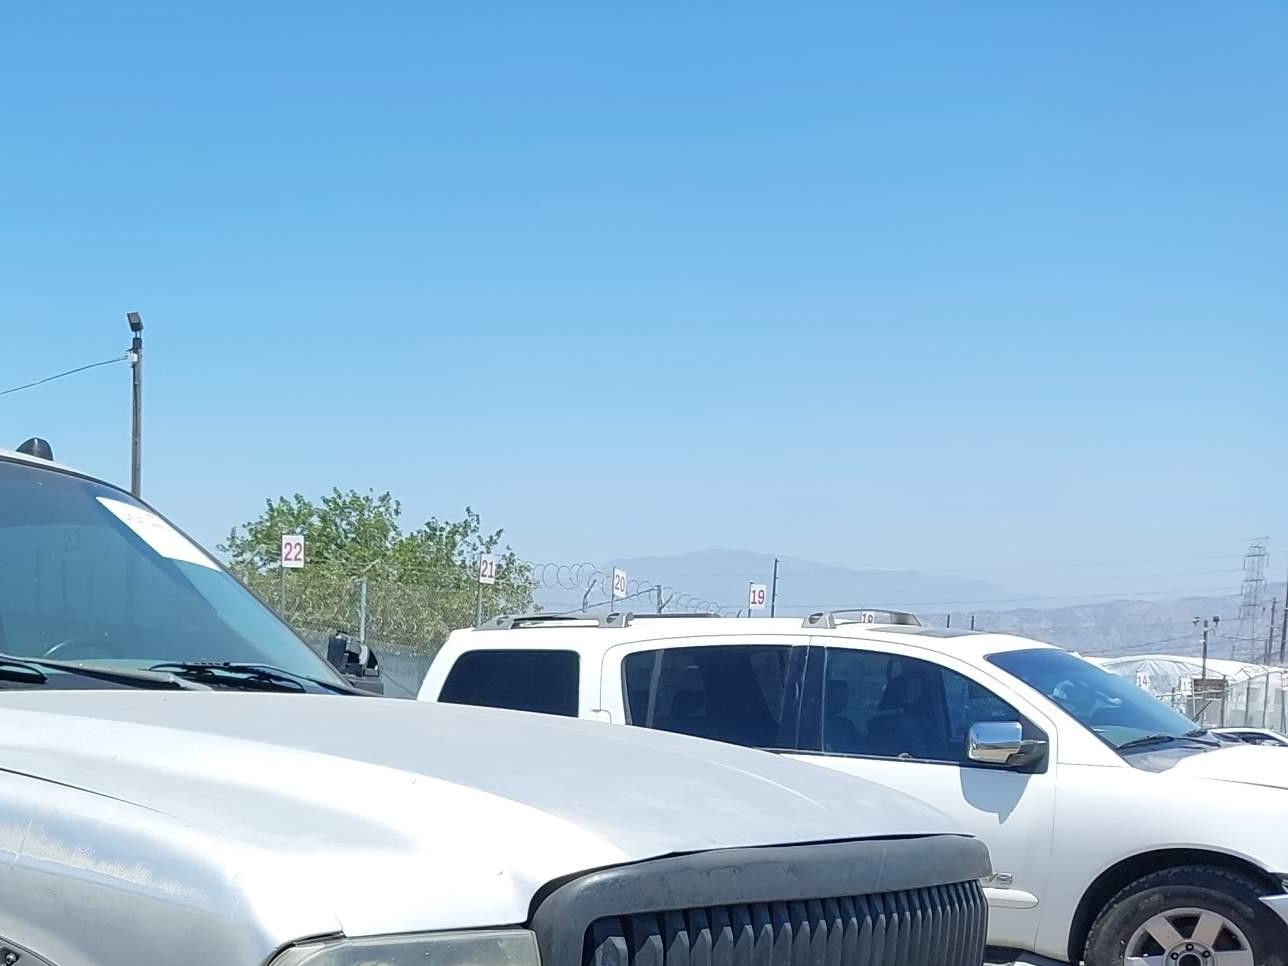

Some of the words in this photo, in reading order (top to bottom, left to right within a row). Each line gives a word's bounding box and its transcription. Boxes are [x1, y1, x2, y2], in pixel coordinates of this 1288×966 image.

[284, 542, 302, 562] 22
[481, 559, 494, 579] 21
[614, 574, 626, 593] 20
[750, 589, 765, 605] 19
